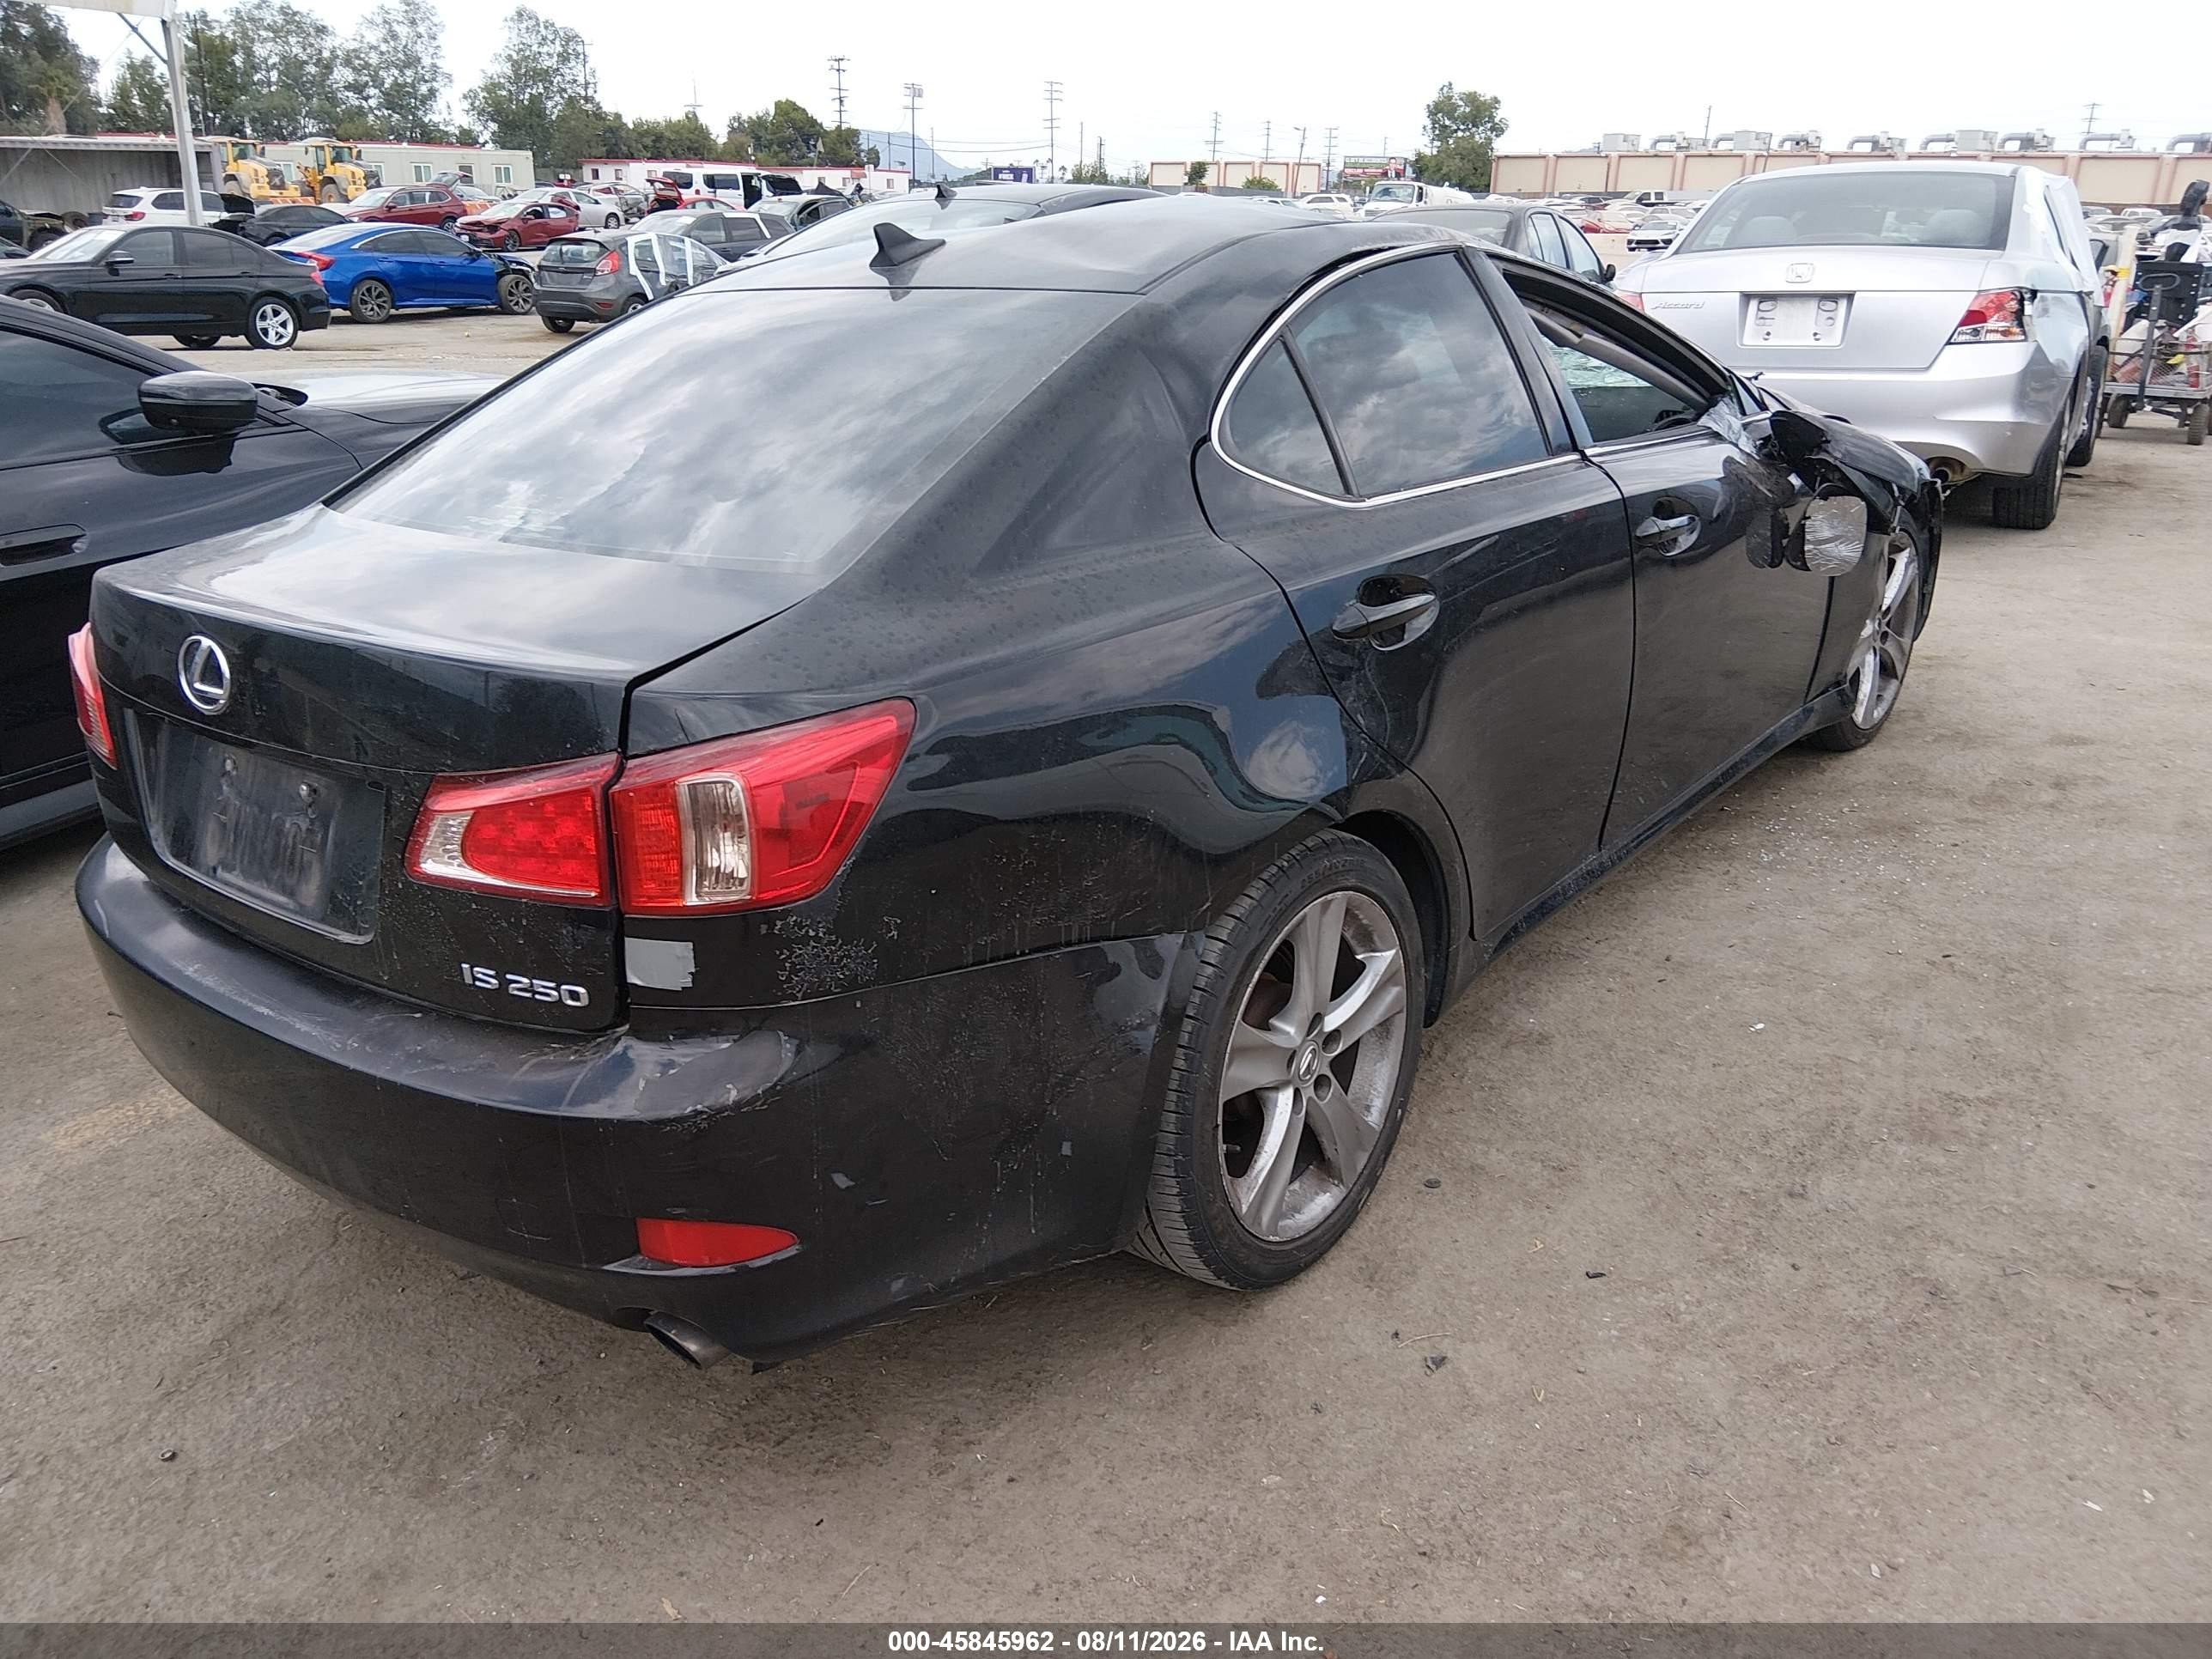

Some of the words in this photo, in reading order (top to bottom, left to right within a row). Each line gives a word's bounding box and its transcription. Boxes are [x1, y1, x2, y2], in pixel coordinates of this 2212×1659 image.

[1650, 300, 1705, 310] Accord
[460, 963, 499, 989] IS
[505, 974, 589, 1007] 250
